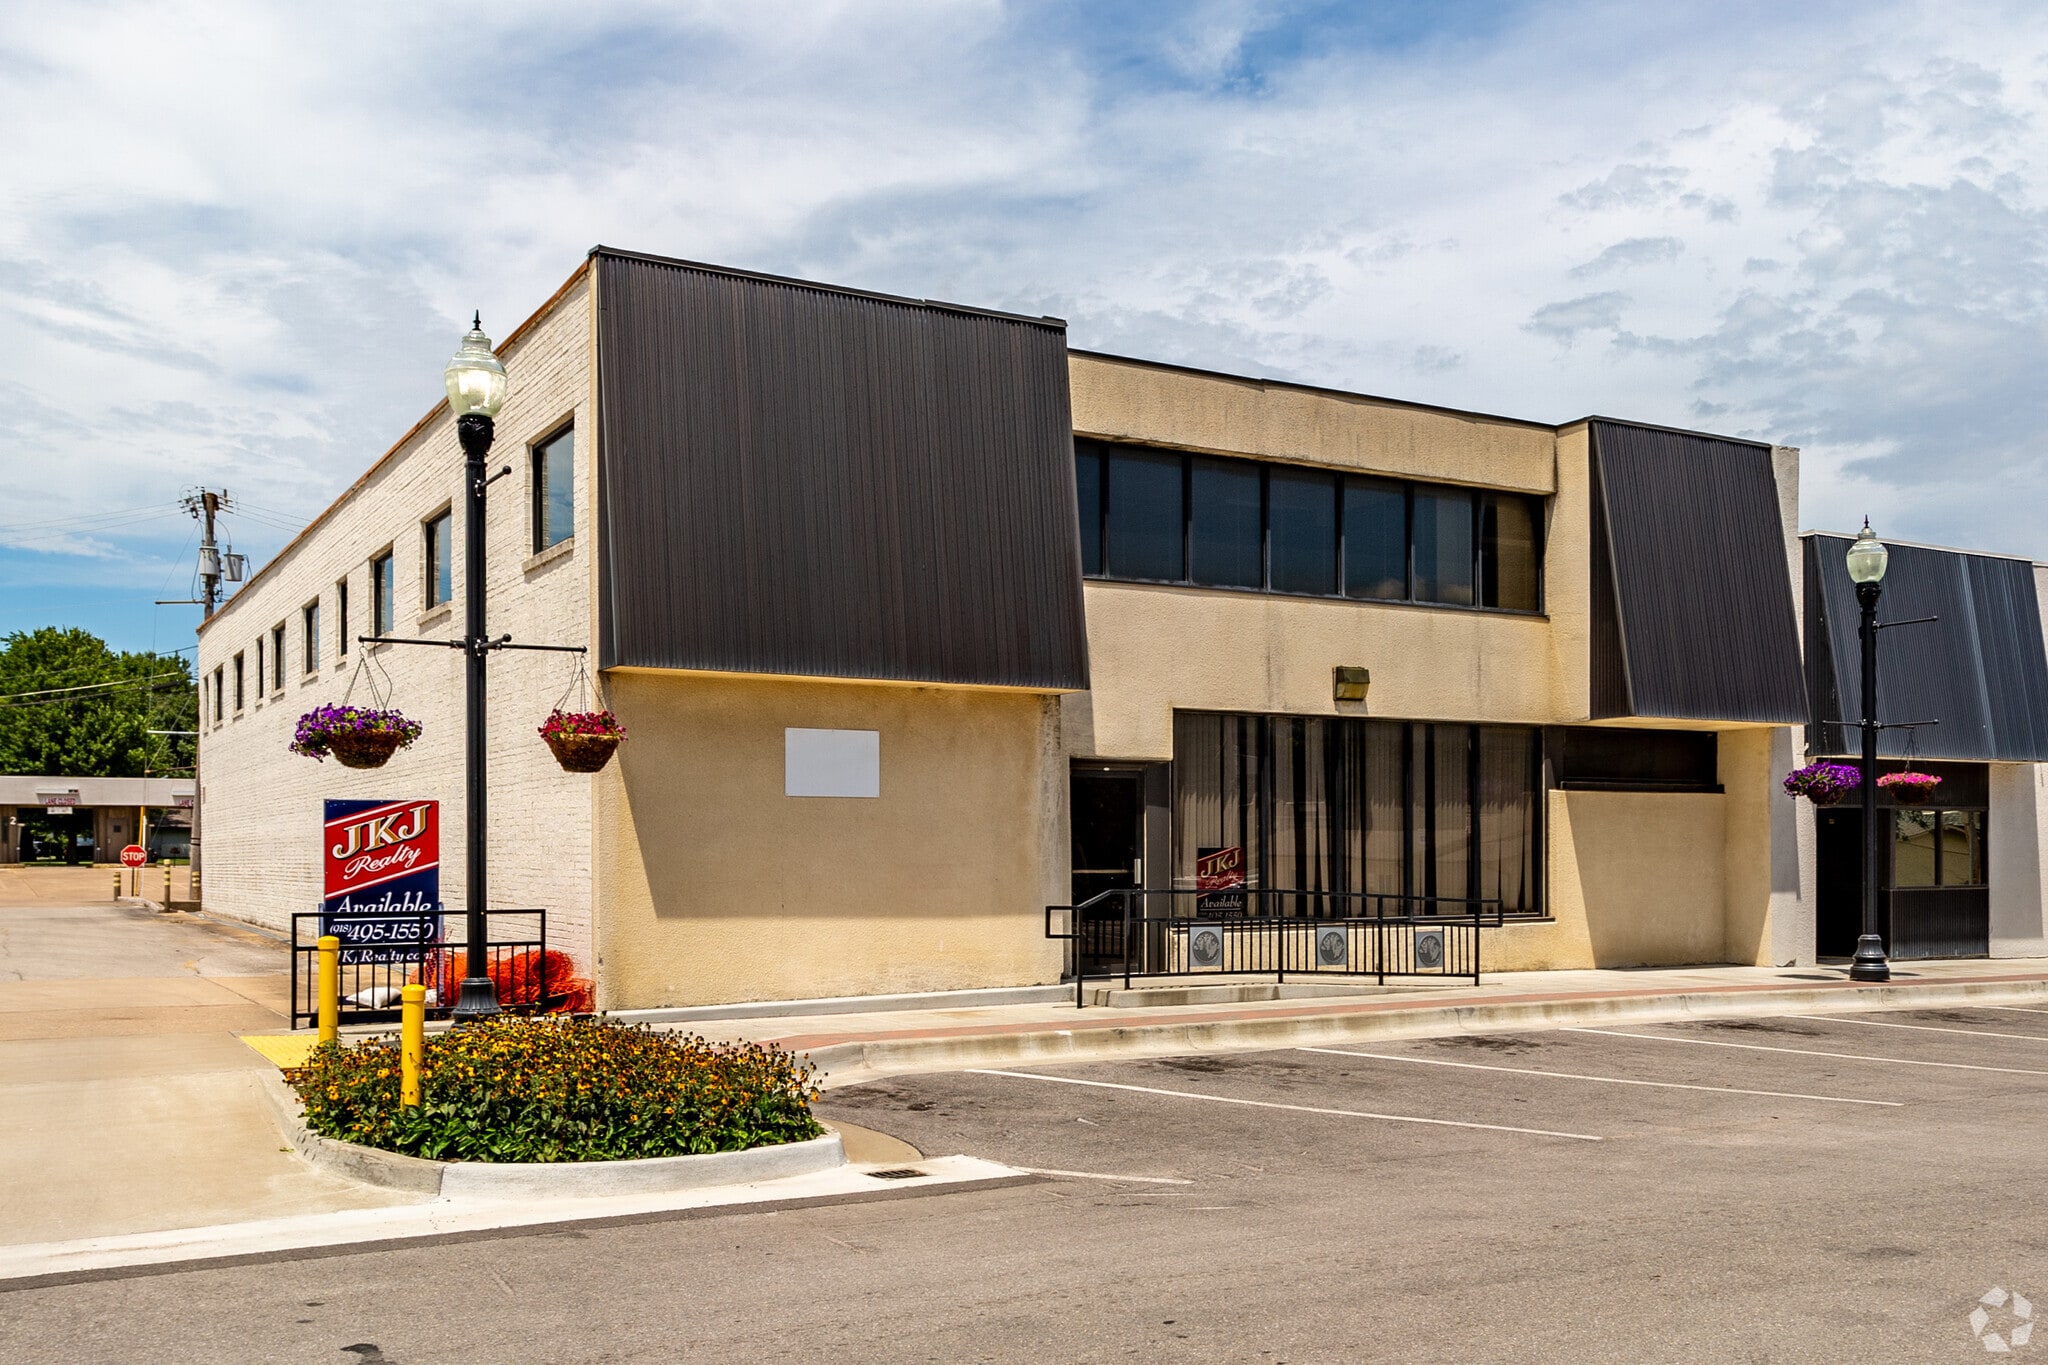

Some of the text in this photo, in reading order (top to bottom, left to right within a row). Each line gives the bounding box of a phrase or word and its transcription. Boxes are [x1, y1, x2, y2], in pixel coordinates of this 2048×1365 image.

[9, 816, 17, 826] 2
[332, 804, 431, 859] JKJ
[122, 851, 145, 861] STOP
[343, 844, 421, 880] Realty
[1200, 849, 1241, 879] JKJ
[1205, 870, 1239, 889] Realty
[336, 891, 432, 913] Available
[1200, 894, 1242, 908] Available
